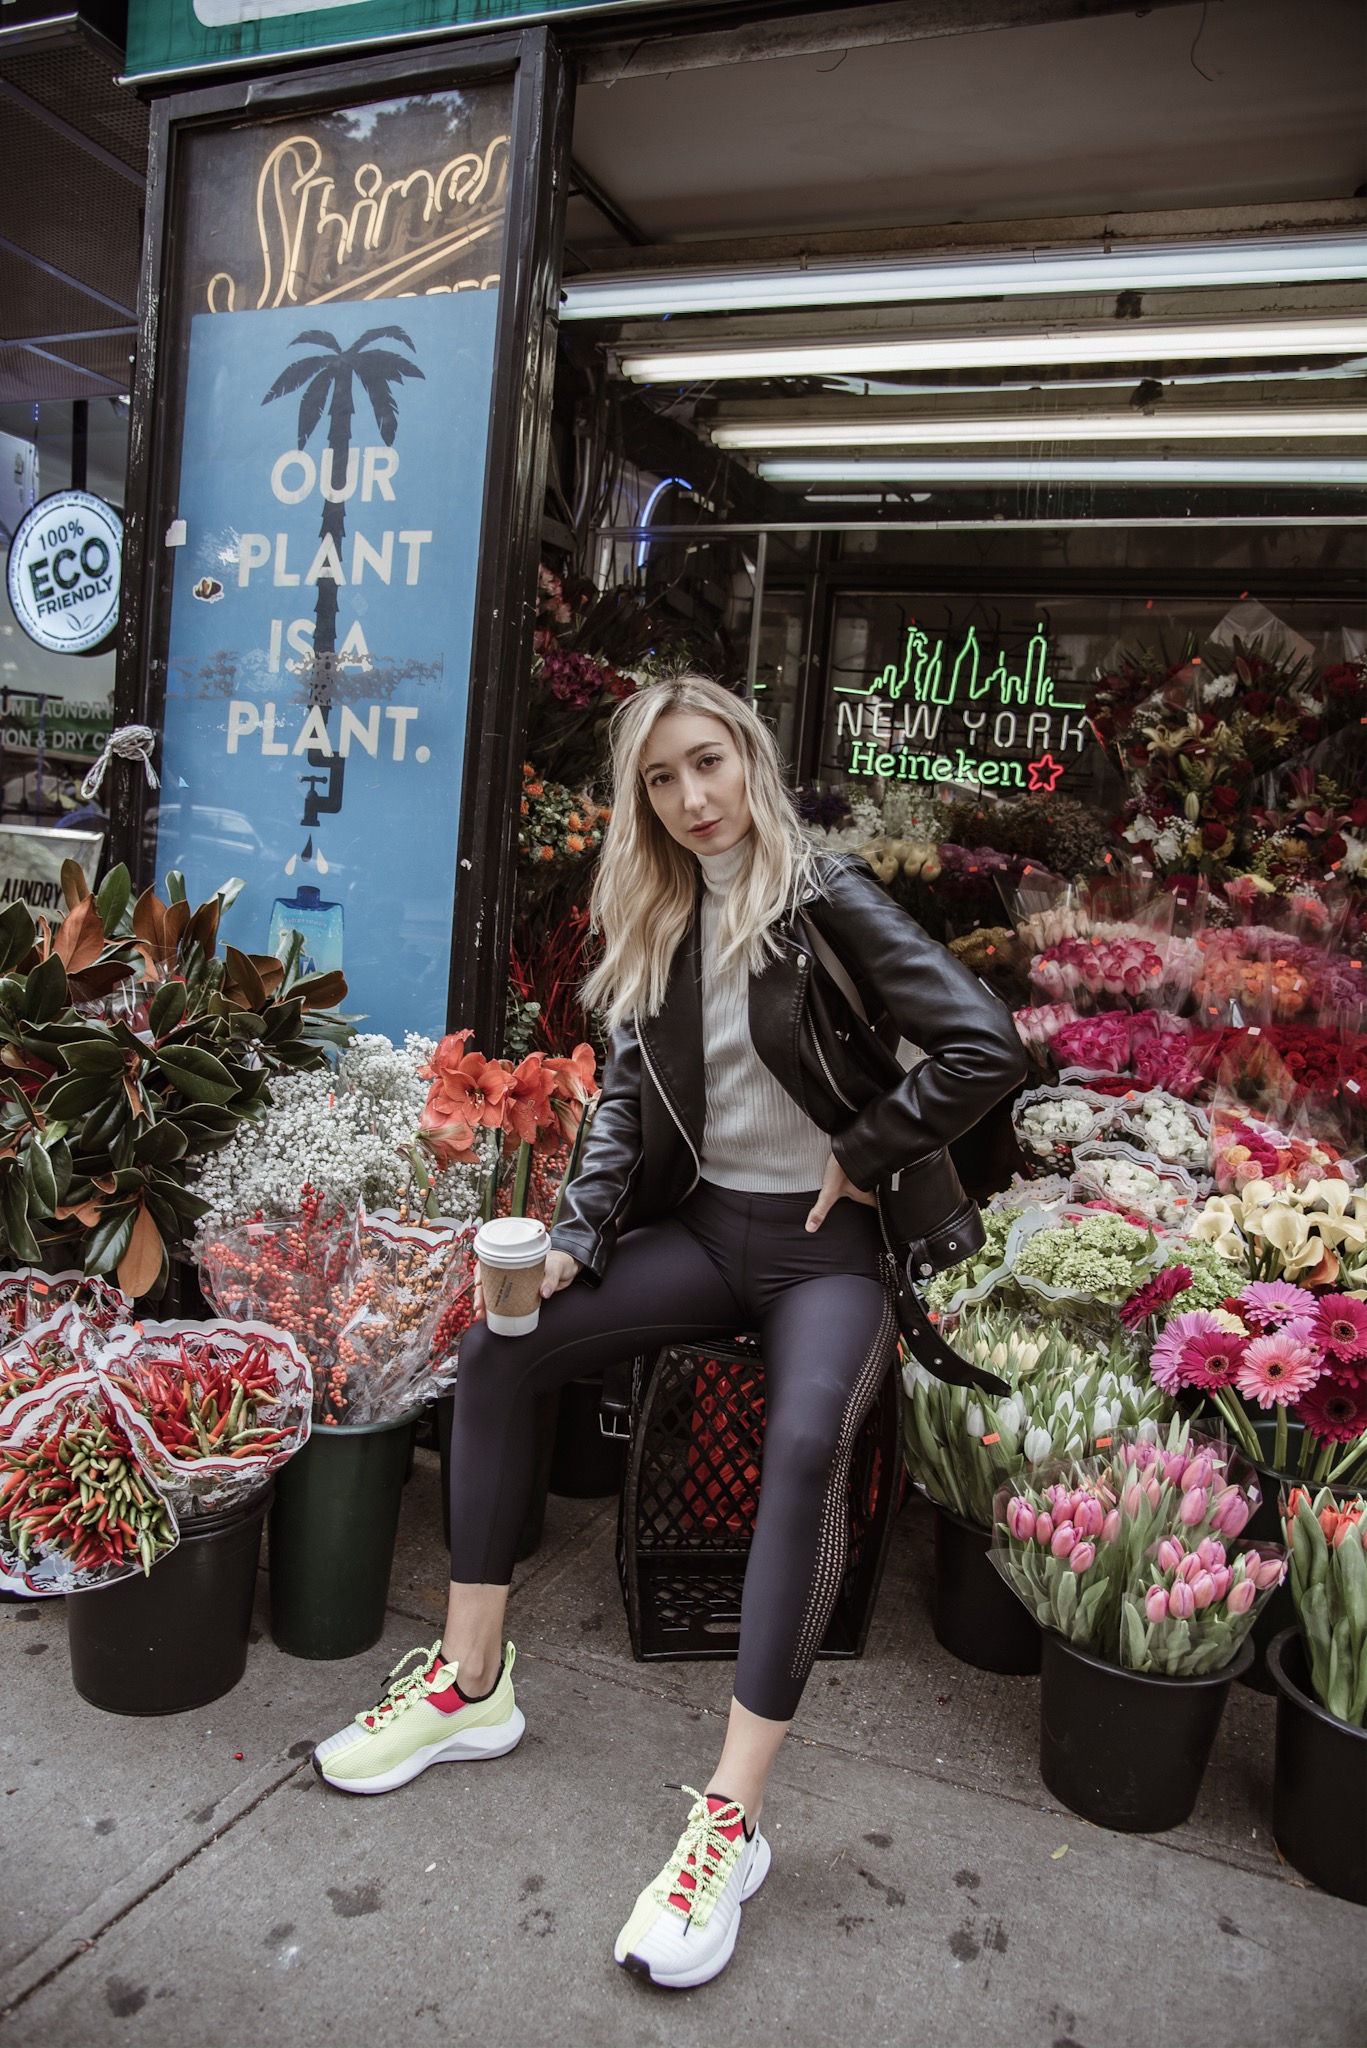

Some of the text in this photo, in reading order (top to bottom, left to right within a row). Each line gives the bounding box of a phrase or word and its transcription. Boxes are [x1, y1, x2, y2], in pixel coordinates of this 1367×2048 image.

[270, 446, 401, 505] OUR
[39, 518, 85, 552] 100%
[238, 530, 433, 587] PLANT
[28, 536, 110, 603] ECO
[36, 575, 114, 619] FRIENDLY
[268, 618, 374, 675] IS A
[31, 700, 113, 720] LAUNDRY
[226, 700, 431, 764] PLANT.
[837, 701, 1090, 752] NEW YORK
[52, 730, 88, 750] DRY
[848, 741, 1027, 788] Heineken
